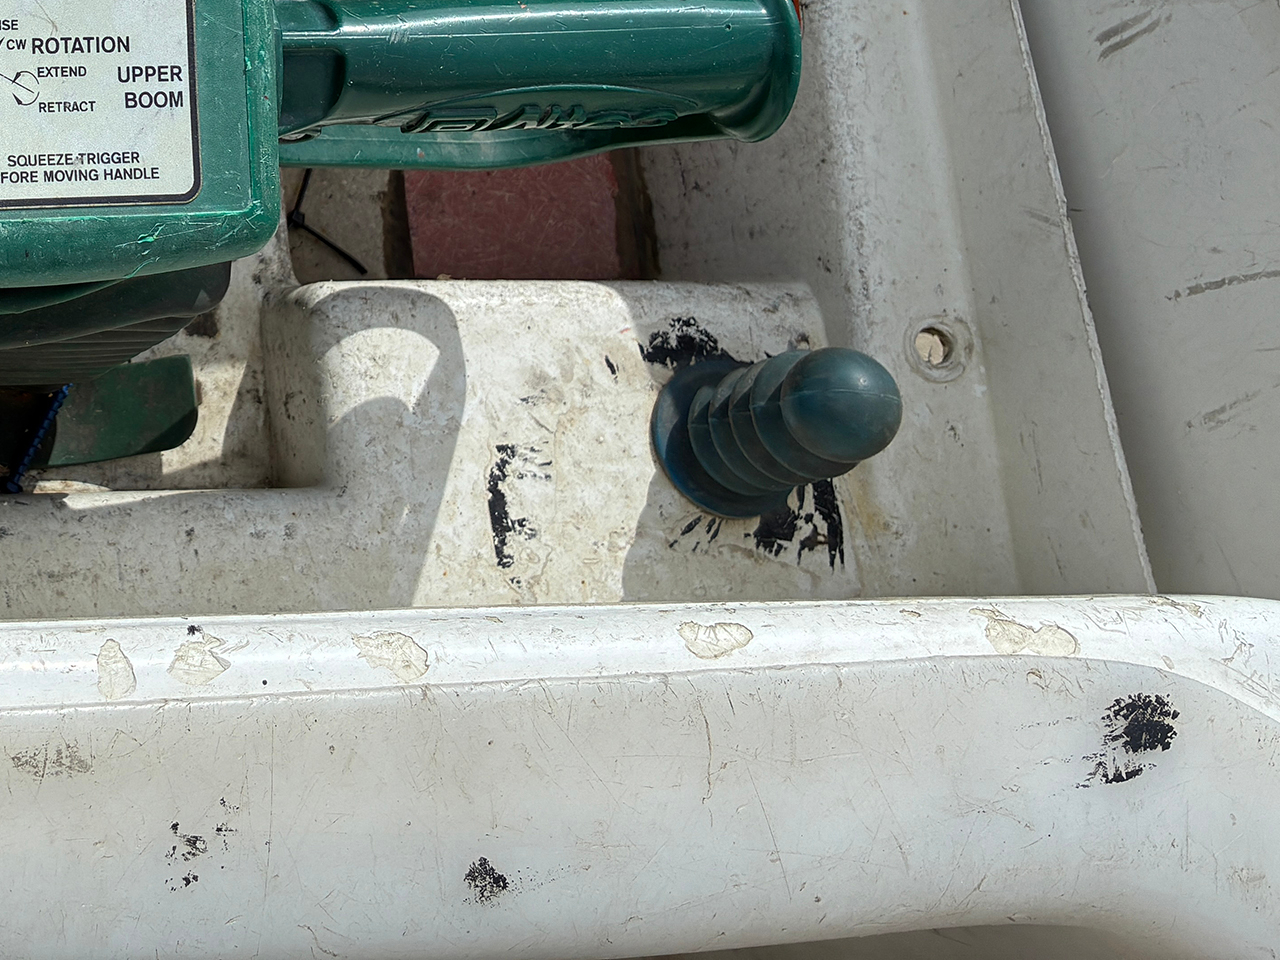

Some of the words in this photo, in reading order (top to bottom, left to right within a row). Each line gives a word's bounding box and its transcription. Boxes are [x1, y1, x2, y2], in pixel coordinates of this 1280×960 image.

[7, 39, 26, 50] CW
[31, 36, 130, 54] ROTATION
[37, 67, 87, 78] EXTEND
[118, 66, 183, 83] UPPER
[38, 101, 96, 113] RETRACT
[125, 91, 184, 108] BOOM
[8, 154, 73, 167] SQUEEZE
[78, 152, 140, 165] TRIGGER
[43, 169, 99, 183] MOVING
[104, 167, 160, 180] HANDLE
